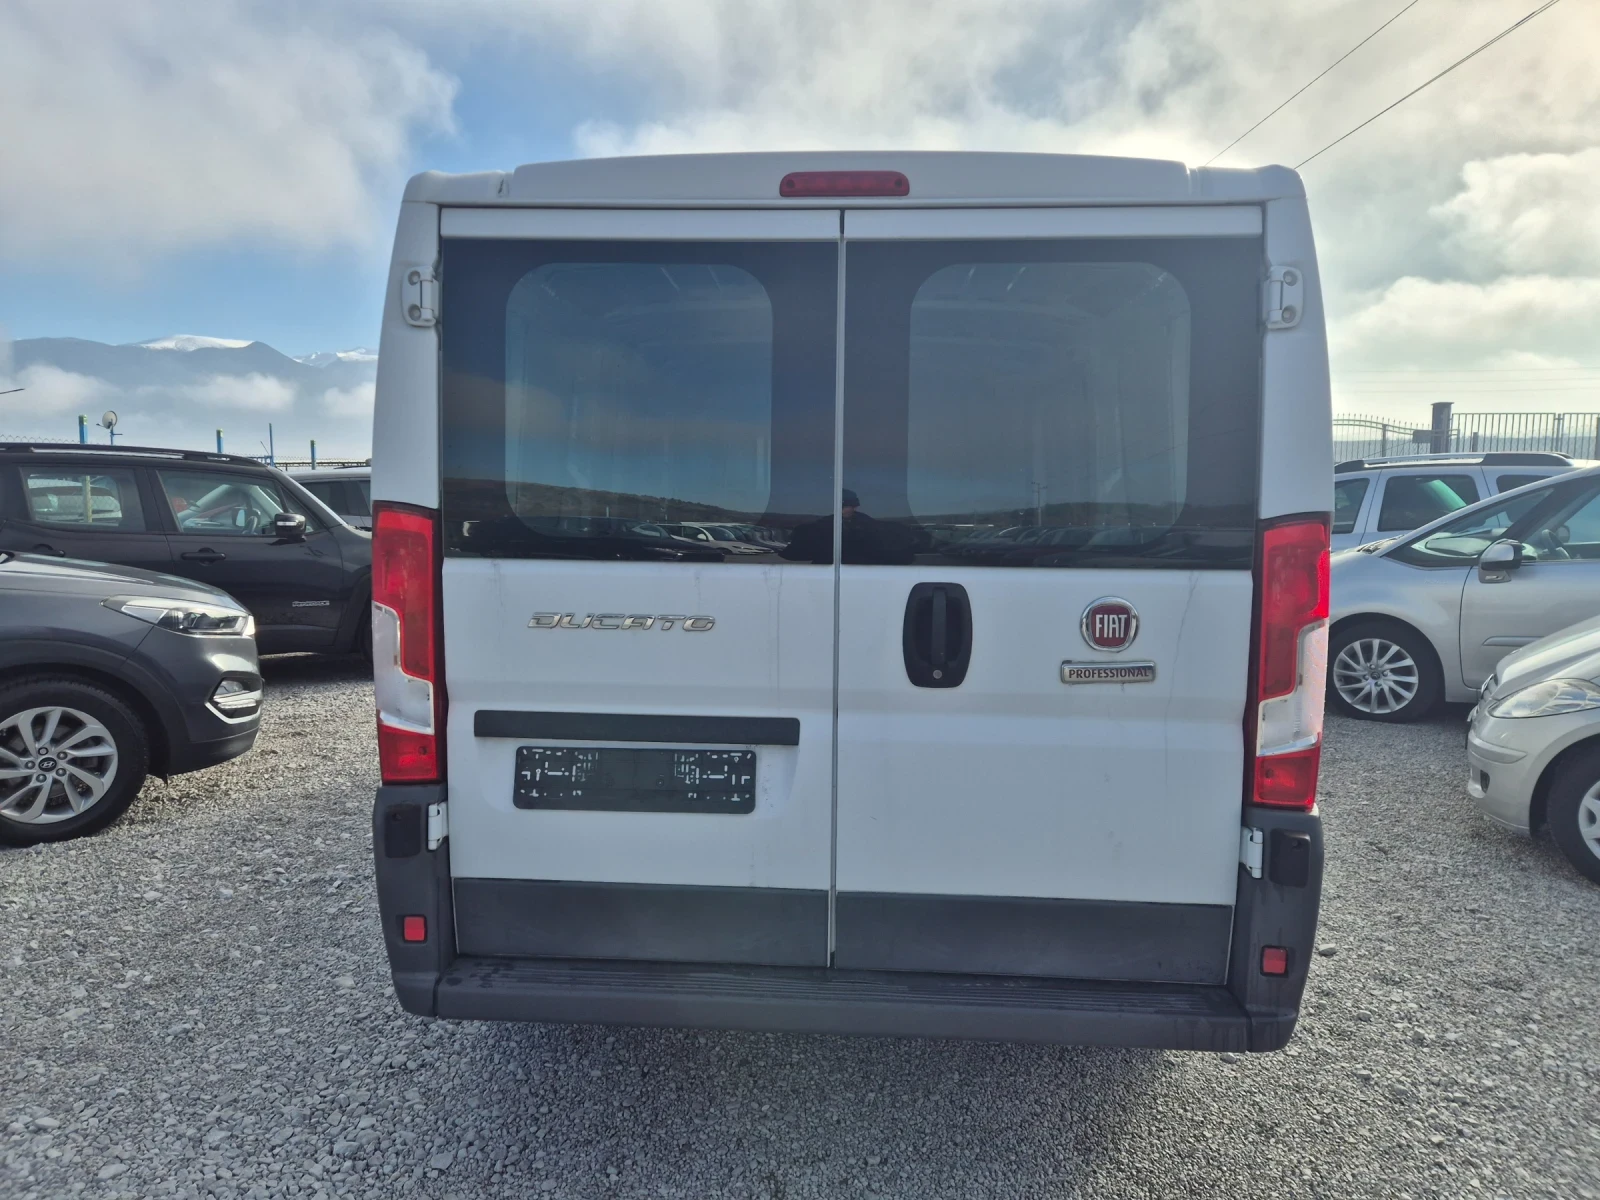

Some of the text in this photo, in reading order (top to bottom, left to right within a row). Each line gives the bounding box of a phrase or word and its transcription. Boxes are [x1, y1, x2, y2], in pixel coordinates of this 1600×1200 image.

[527, 611, 715, 632] DUCATO
[1095, 614, 1128, 638] FIAT
[1068, 667, 1150, 679] PROFESSIONAL
